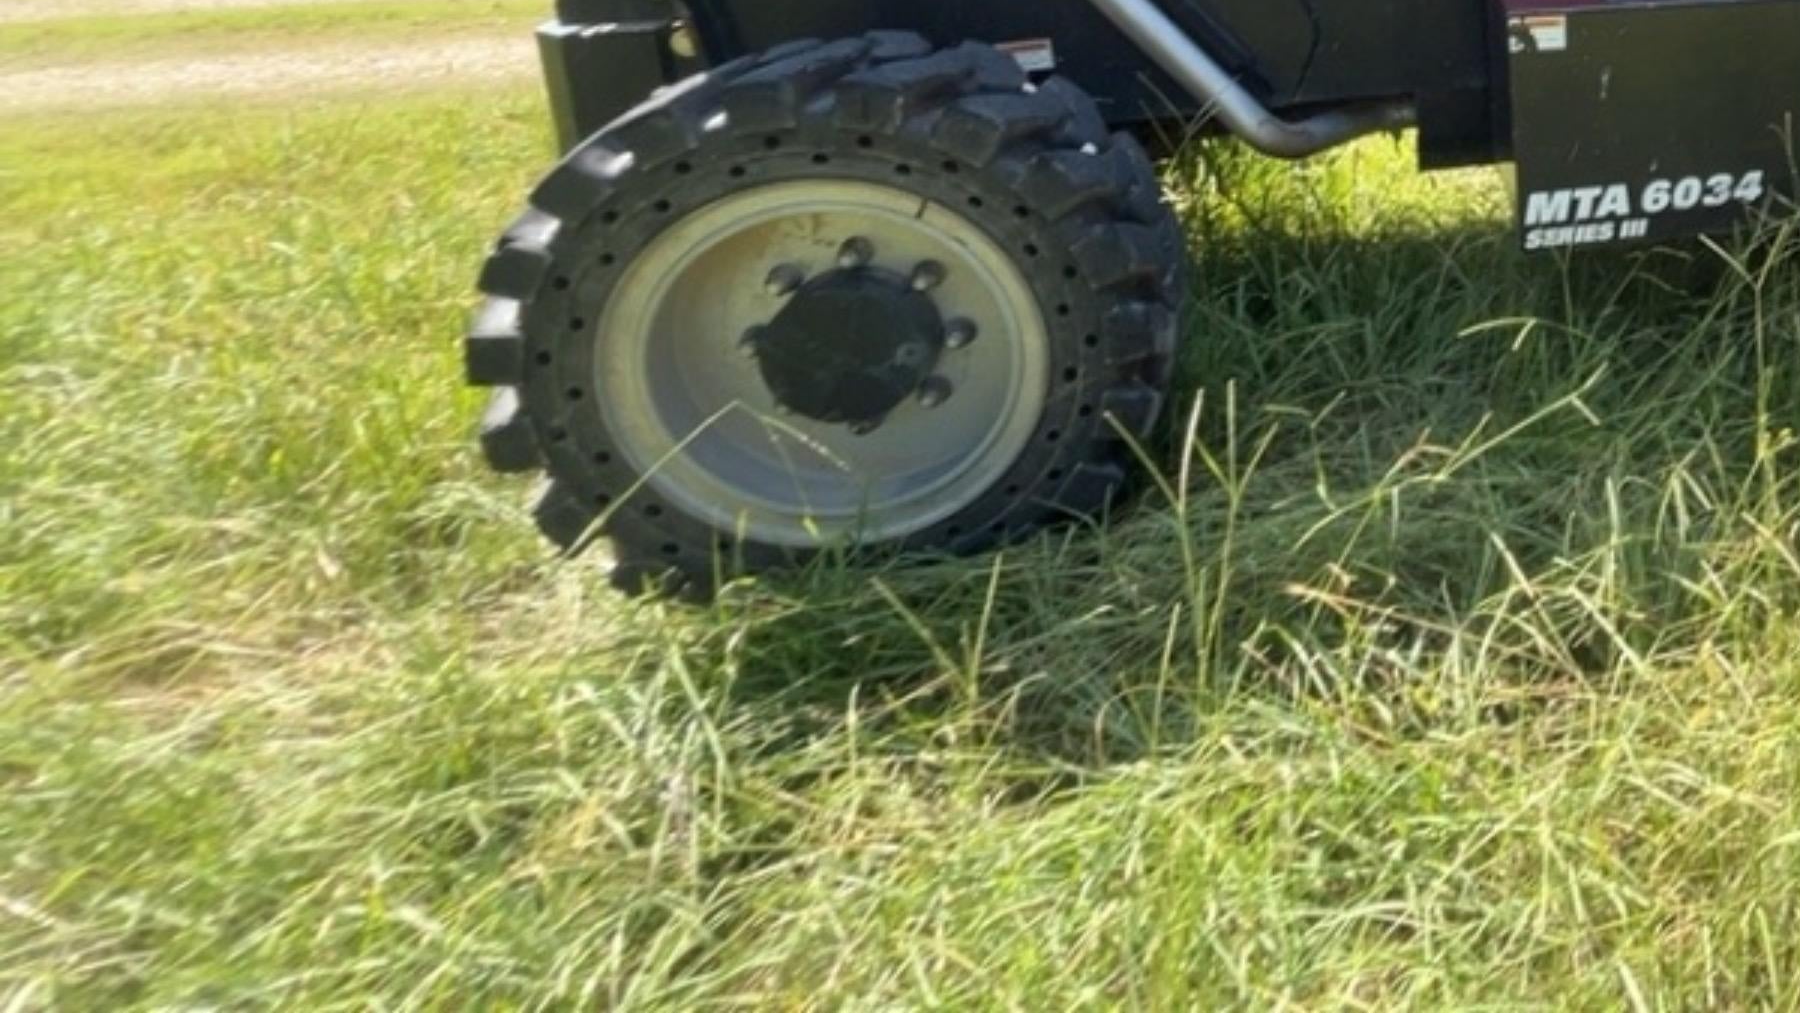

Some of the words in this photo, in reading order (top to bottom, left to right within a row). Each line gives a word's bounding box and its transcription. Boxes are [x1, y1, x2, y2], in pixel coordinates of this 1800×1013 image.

[1524, 183, 1631, 226] MTA
[1640, 169, 1764, 214] 6034
[1523, 220, 1615, 250] SERIES
[1619, 216, 1649, 239] III
